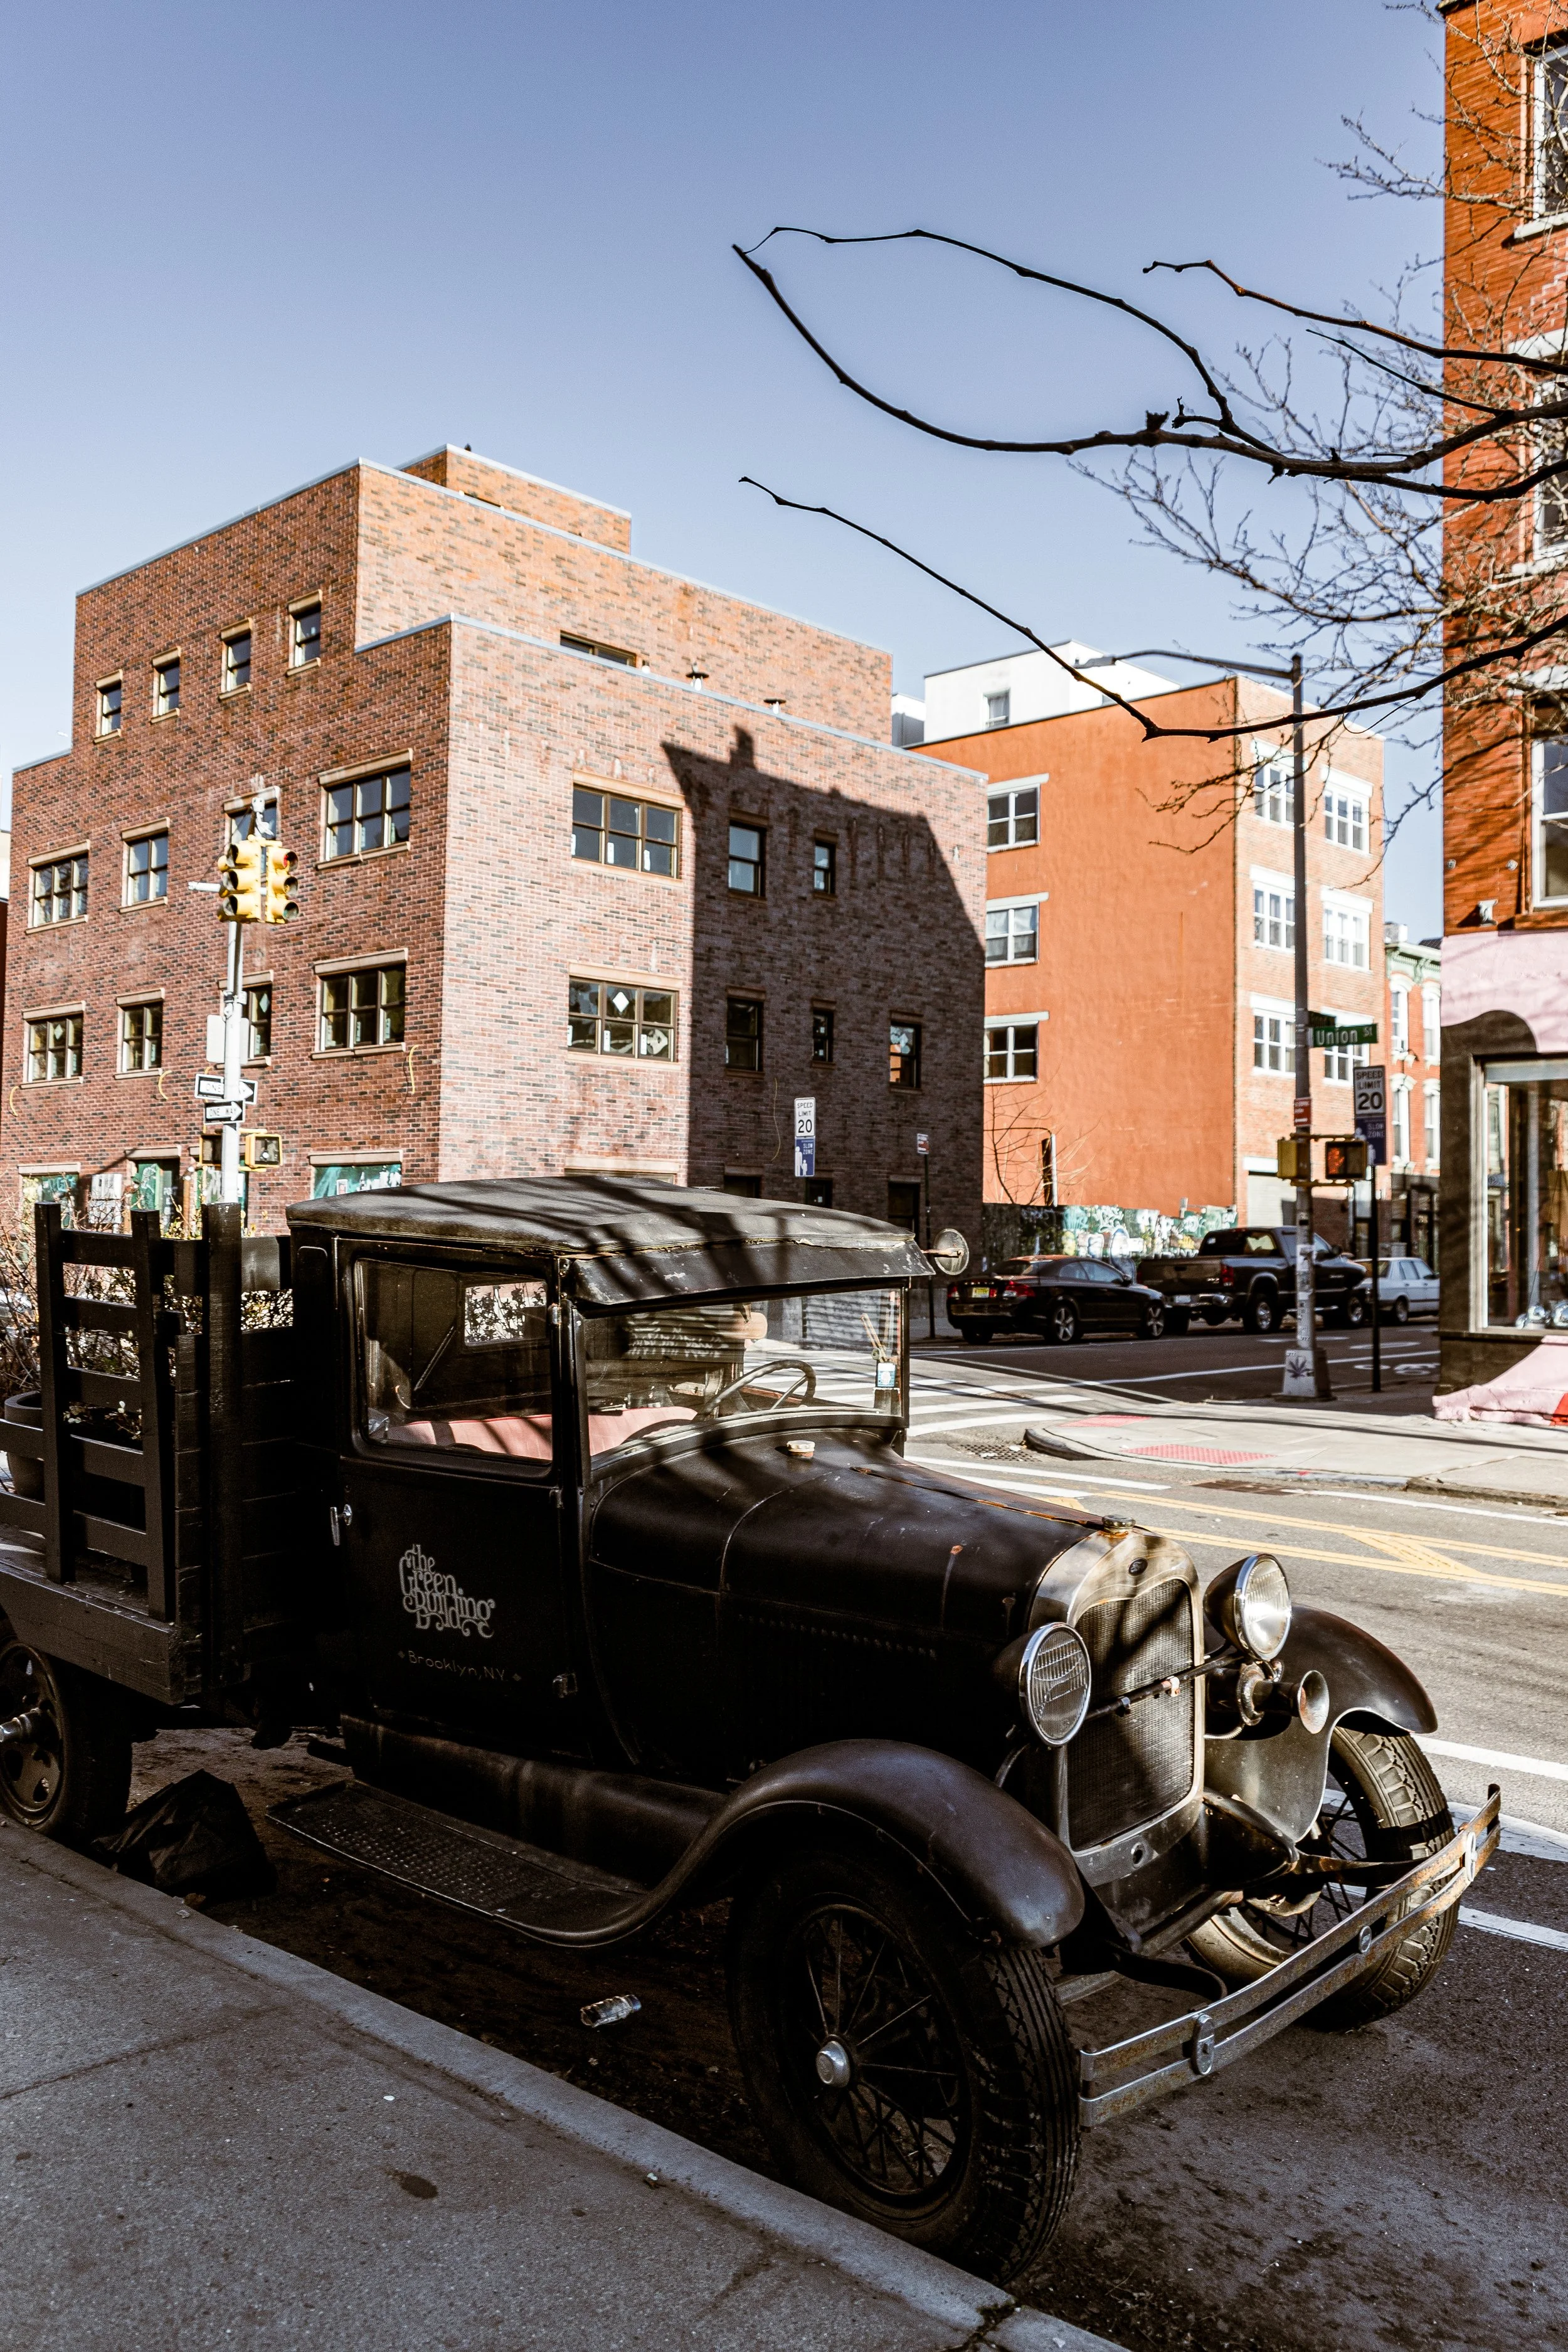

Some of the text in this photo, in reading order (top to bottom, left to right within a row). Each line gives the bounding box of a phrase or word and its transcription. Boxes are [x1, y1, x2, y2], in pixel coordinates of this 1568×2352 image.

[1316, 1026, 1373, 1046] Union St
[1356, 1070, 1384, 1080] SPEED
[205, 1083, 221, 1093] ONE
[1357, 1080, 1381, 1090] LIMIT
[1358, 1091, 1382, 1110] 20
[209, 1108, 220, 1116] ONE
[798, 1119, 813, 1133] 20
[399, 1556, 457, 1597] Green
[403, 1587, 496, 1638] Building
